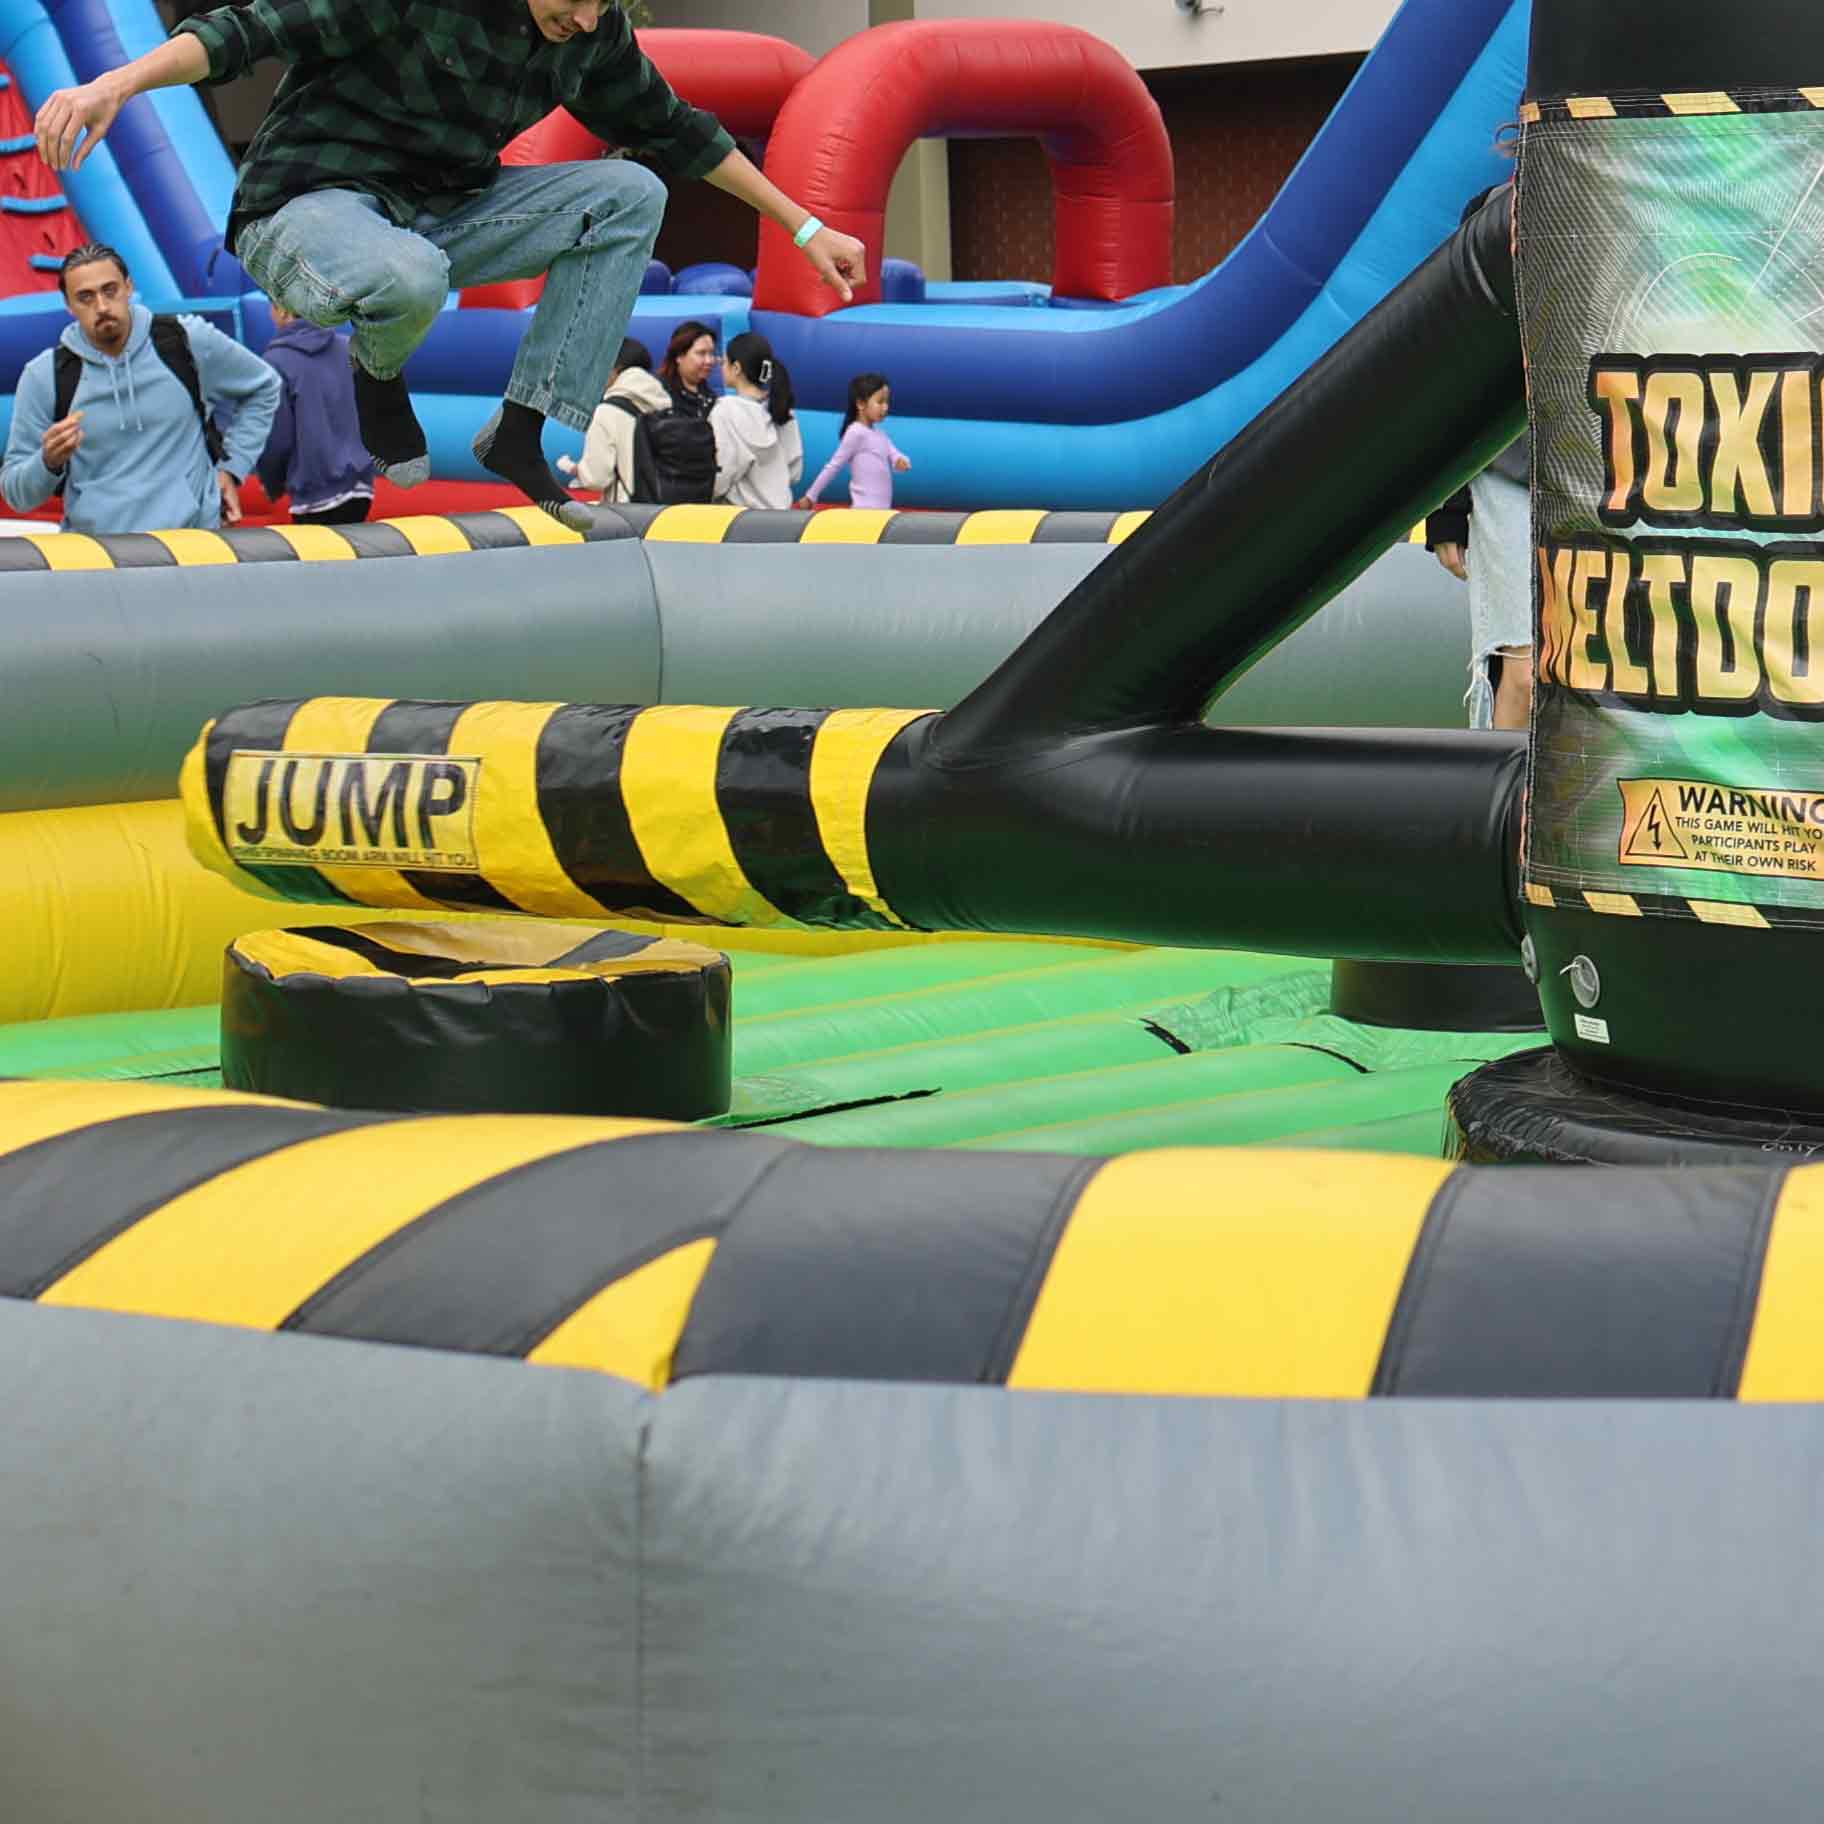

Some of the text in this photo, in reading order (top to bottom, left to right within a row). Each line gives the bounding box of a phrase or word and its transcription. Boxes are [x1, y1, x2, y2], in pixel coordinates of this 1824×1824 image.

[236, 759, 467, 849] JUMP
[1676, 816, 1701, 829] THIS
[1704, 819, 1743, 832] GAME
[1747, 822, 1777, 835] WILL
[1782, 824, 1801, 838] HIT
[1692, 834, 1816, 854] PARTICIPANTS PLAY
[1694, 851, 1816, 872] AT THEIR OWN RISK
